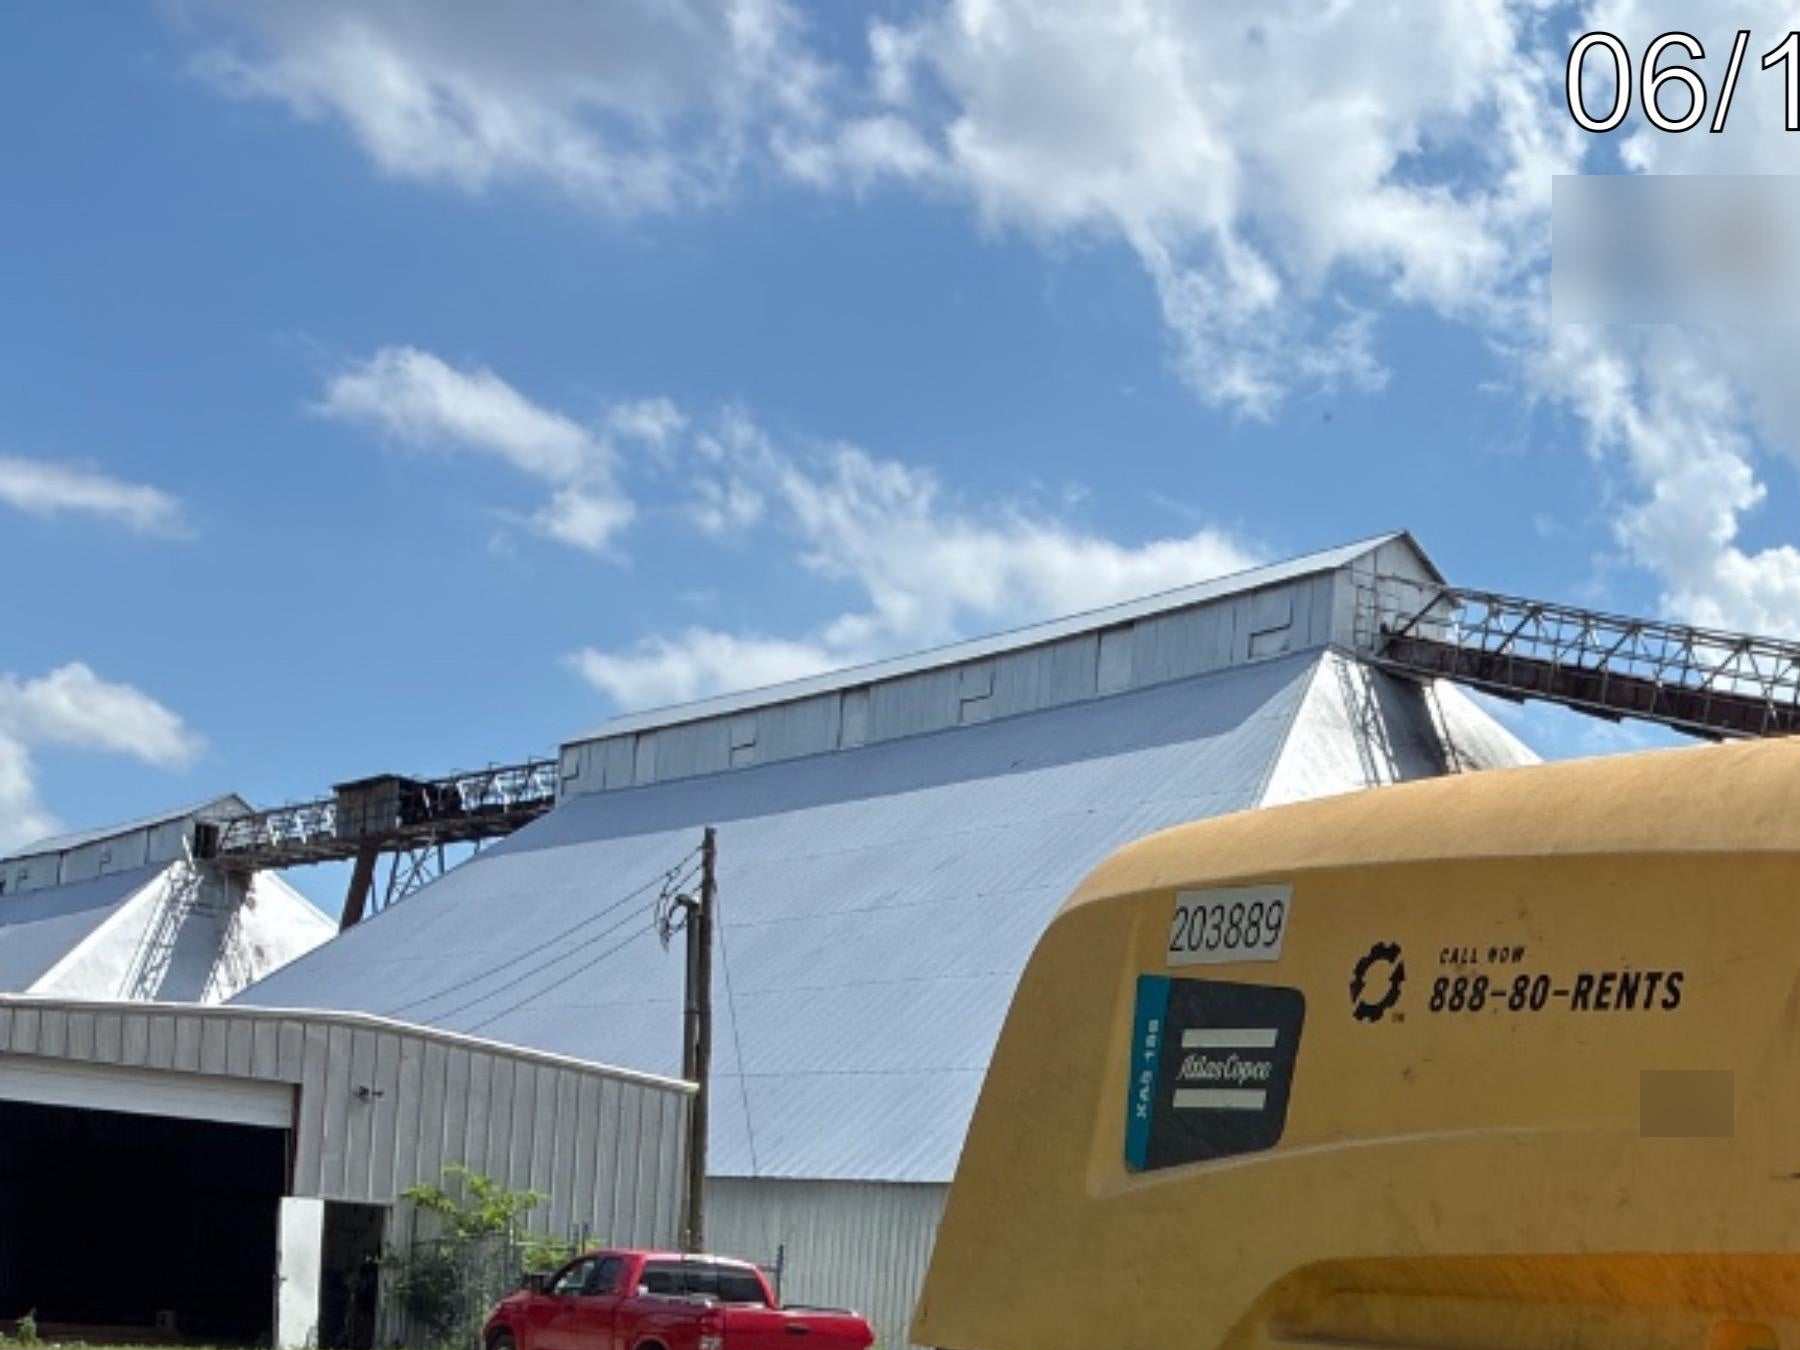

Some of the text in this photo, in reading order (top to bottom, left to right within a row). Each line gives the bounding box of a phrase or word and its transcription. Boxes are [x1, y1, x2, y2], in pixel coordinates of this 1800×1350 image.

[1169, 899, 1284, 952] 203889
[1439, 945, 1526, 964] CALL NOW
[1429, 971, 1684, 1012] 888-80-RENTS
[1176, 1052, 1272, 1086] Atlas Copco
